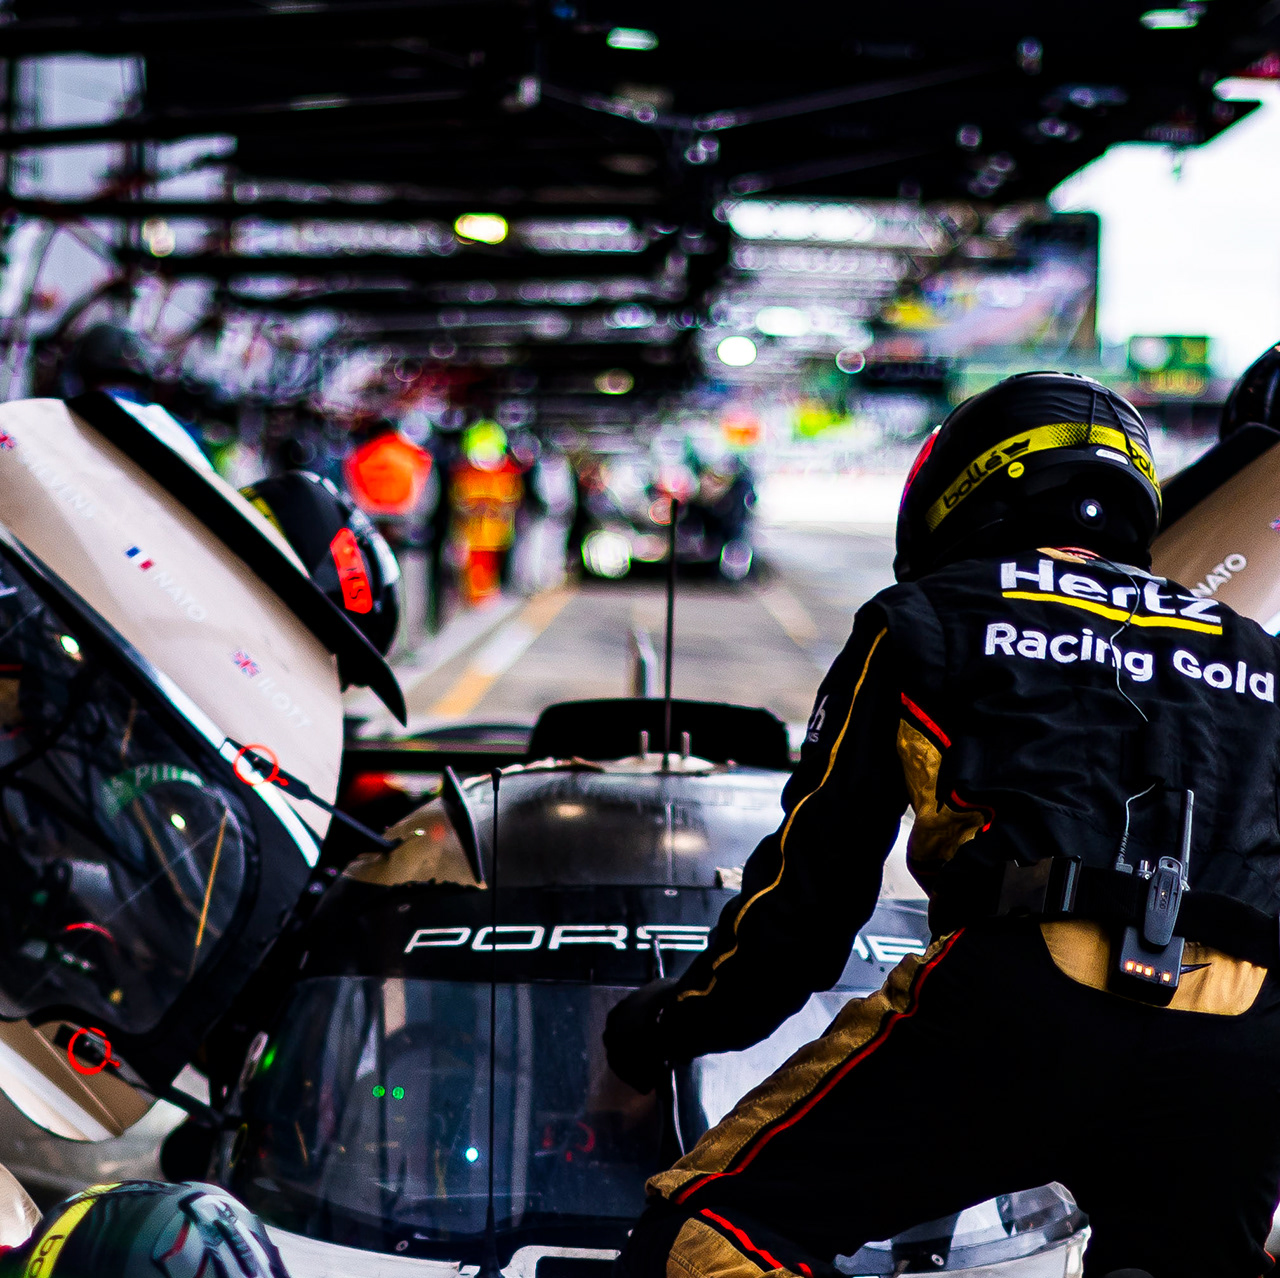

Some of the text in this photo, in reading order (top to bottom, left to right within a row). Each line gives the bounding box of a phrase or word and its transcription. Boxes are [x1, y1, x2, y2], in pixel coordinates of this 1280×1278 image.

[942, 448, 1004, 510] bollé
[1000, 558, 1222, 624] Hertz
[1190, 552, 1248, 598] NATO
[984, 621, 1275, 703] Racing Gold
[404, 925, 928, 963] PORSE
